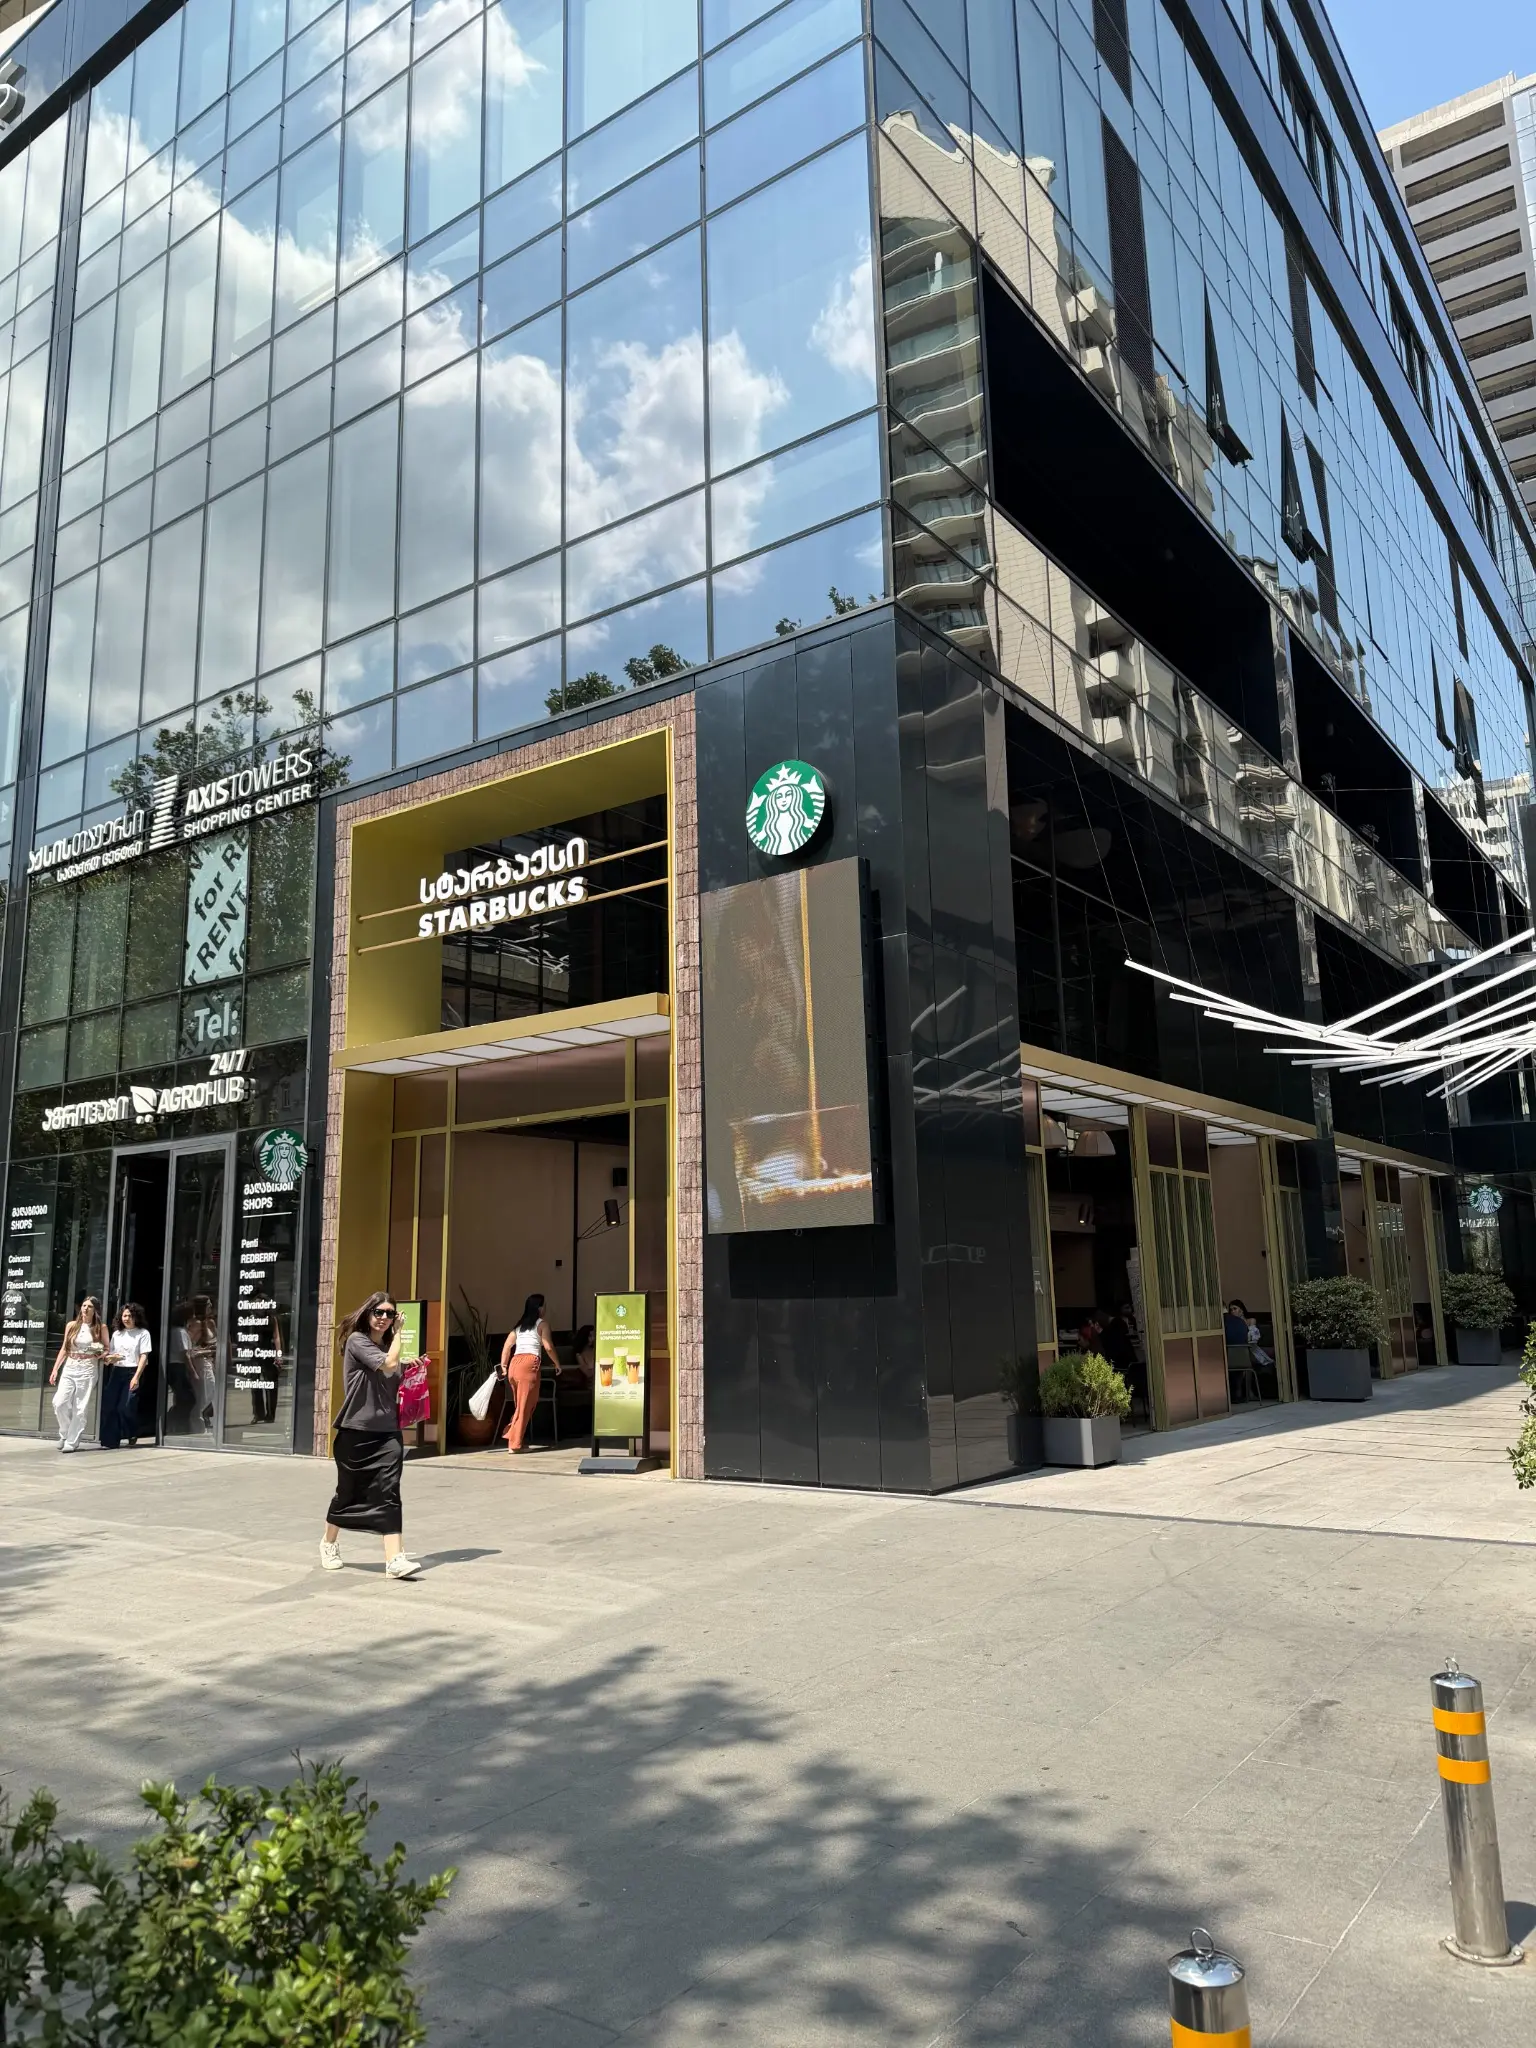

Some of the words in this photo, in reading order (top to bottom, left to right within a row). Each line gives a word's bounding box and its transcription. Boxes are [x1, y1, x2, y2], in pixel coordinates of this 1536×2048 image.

[183, 803, 252, 838] SHOPPING
[255, 783, 312, 814] CENTER
[419, 837, 586, 904] სტარბაქსი
[195, 871, 224, 921] for
[418, 876, 585, 938] STARBUCKS
[197, 879, 247, 971] RENT
[194, 1001, 239, 1042] Tel:
[209, 1050, 246, 1076] 24/7
[157, 1076, 245, 1114] AGROHUB
[242, 1197, 273, 1211] SHOPS
[10, 1219, 33, 1231] SHOPS
[241, 1238, 259, 1249] Penti
[240, 1251, 279, 1264] REDBERRY
[239, 1268, 266, 1280] Podium
[6, 1280, 24, 1290] Fitness
[24, 1279, 45, 1289] Formula
[239, 1285, 254, 1295] PSP
[4, 1307, 16, 1316] GPC
[237, 1332, 259, 1342] Tsvara
[1, 1346, 24, 1356] Engraver
[236, 1348, 254, 1358] Tutto
[254, 1347, 283, 1360] Capsue
[15, 1360, 25, 1370] des
[234, 1378, 275, 1391] Equivalenza
